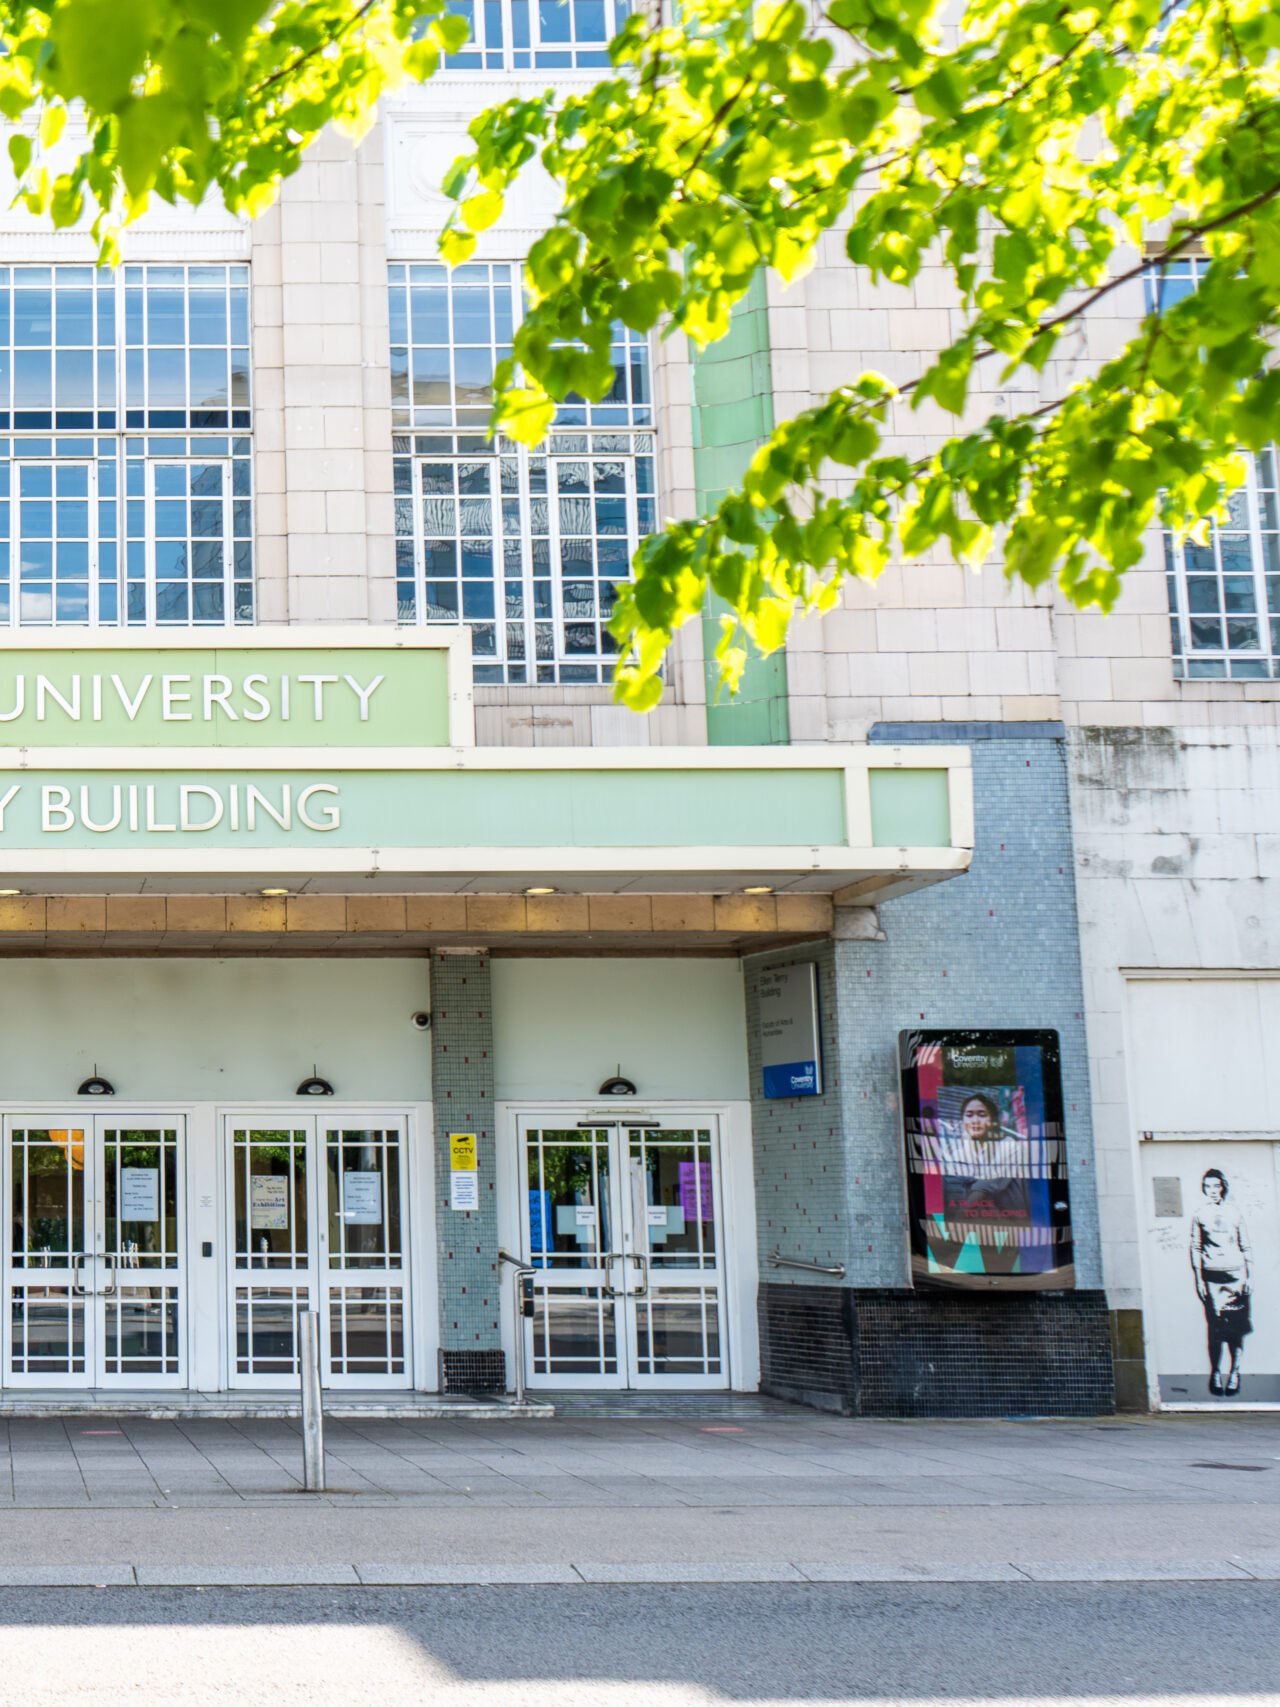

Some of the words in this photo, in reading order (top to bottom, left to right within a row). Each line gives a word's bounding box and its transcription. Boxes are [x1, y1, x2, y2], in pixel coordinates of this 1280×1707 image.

[41, 783, 341, 832] BUILDING
[952, 1055, 988, 1063] Coventry
[964, 1209, 978, 1217] TO
[981, 1209, 1027, 1217] BELONG
